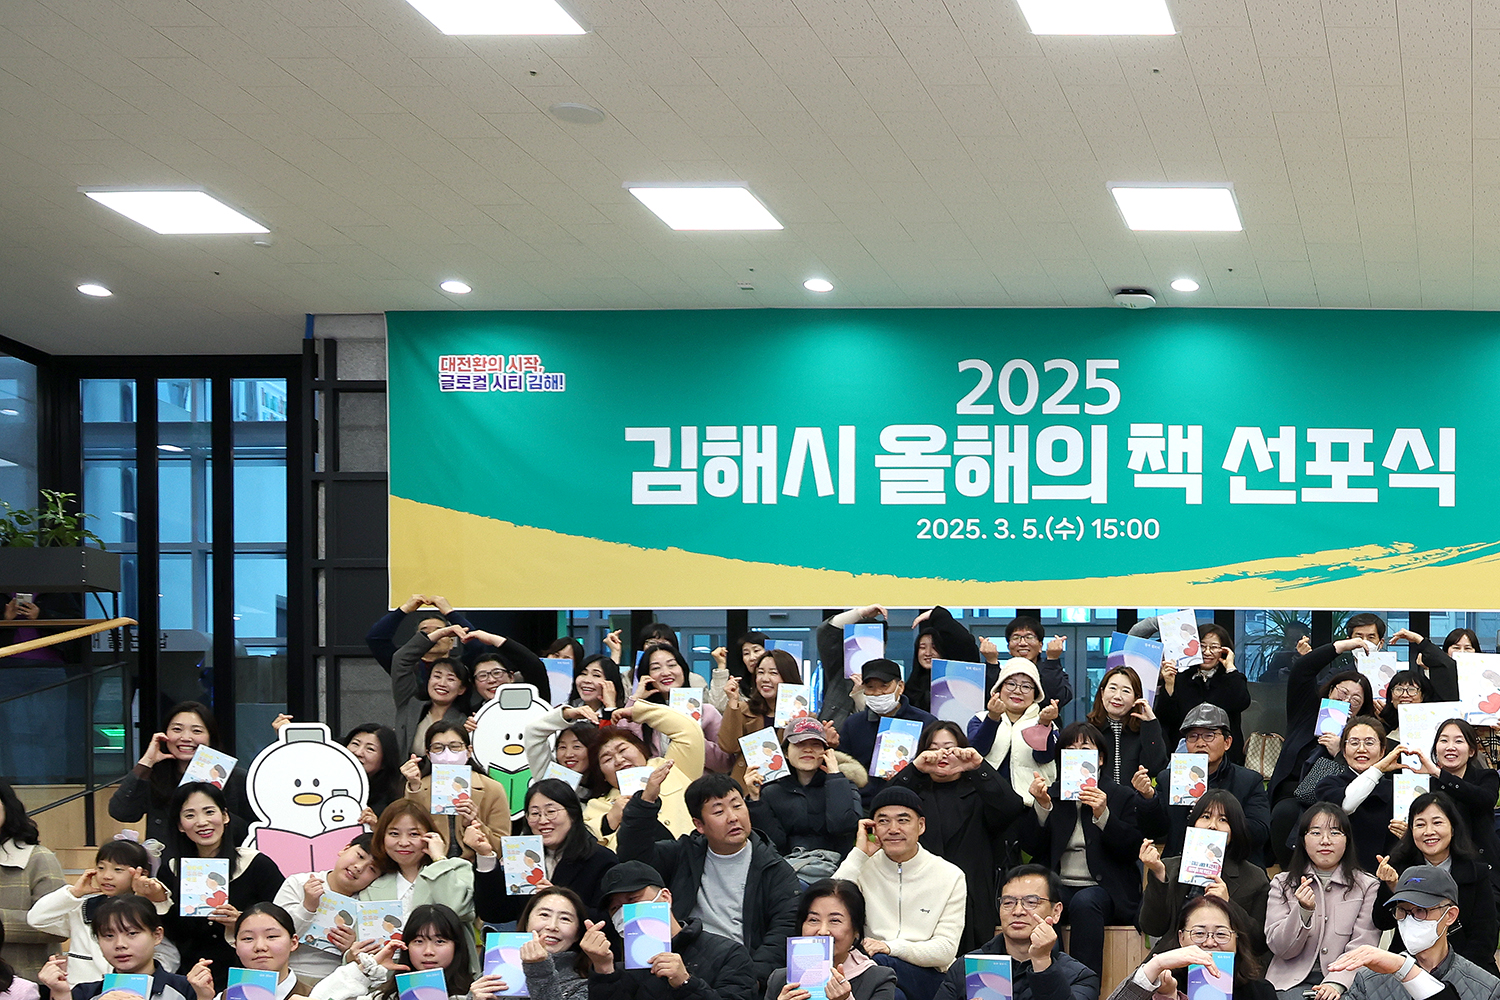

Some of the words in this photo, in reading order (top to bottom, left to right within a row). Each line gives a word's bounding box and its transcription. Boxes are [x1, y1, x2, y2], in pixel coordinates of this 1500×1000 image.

[440, 356, 503, 373] 대전환의
[507, 356, 545, 374] 시작,
[440, 374, 488, 391] 글로컬
[492, 374, 523, 391] 시티
[527, 374, 565, 391] 김해!
[956, 359, 1121, 415] 2025
[625, 425, 856, 505] 김해시
[874, 424, 1108, 505] 올해의
[1127, 423, 1203, 505] 책
[1221, 424, 1456, 507] 선포식
[916, 517, 987, 541] 2025.
[993, 517, 1016, 541] 3.
[1022, 516, 1085, 542] 5.(수)
[1091, 517, 1160, 541] 15:00
